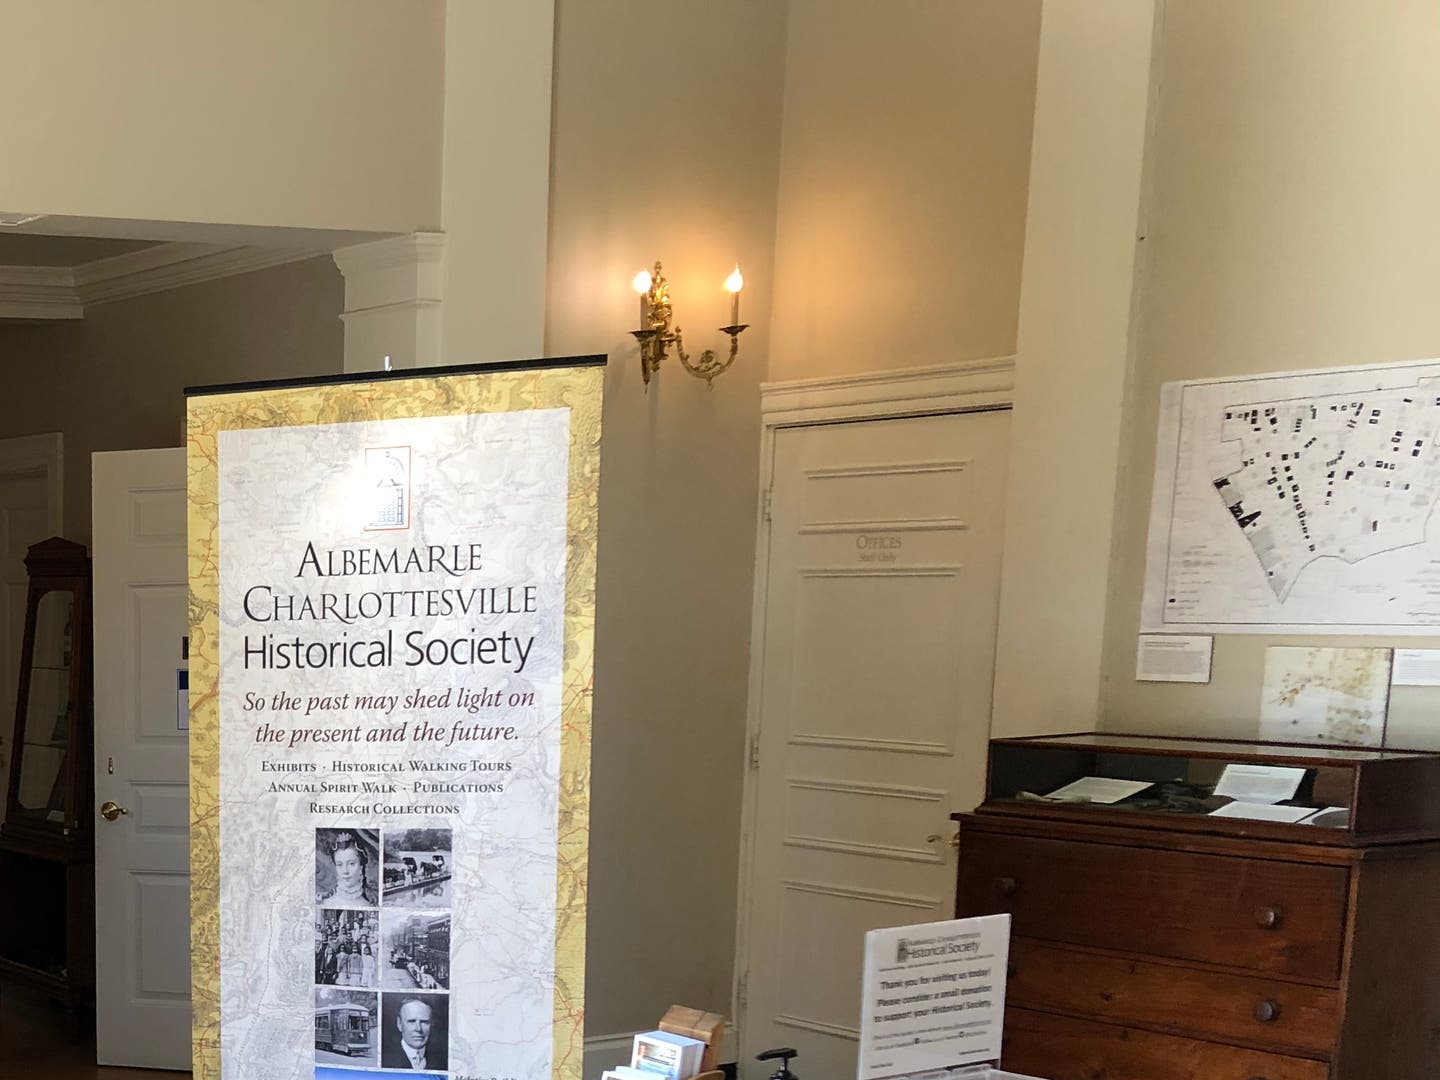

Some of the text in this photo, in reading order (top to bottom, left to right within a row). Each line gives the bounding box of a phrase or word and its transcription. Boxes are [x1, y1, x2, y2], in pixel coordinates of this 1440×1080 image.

[295, 541, 482, 578] ALBEMARLE
[244, 585, 537, 623] CHARLOTTESVILLE
[244, 630, 534, 673] Historical Society
[244, 688, 534, 715] So the past may shed light on
[256, 723, 519, 747] the present and the future.
[261, 760, 512, 772] EXHIBITS HISTORICAL WALKING TOURS
[269, 782, 504, 793] ANNUAL SPIRIT WALK PUBLICATIONS
[310, 803, 459, 814] RESEARCH COLLECTIONS
[906, 941, 981, 960] Historical Society
[881, 980, 902, 990] Thank
[905, 979, 917, 989] you
[920, 976, 930, 984] for
[932, 972, 957, 983] visiting
[877, 996, 901, 1007] Please
[902, 994, 933, 1005] consider
[940, 988, 960, 999] small
[961, 985, 992, 996] donation
[884, 1011, 912, 1023] support
[914, 1010, 929, 1018] your
[932, 1003, 965, 1015] Historical
